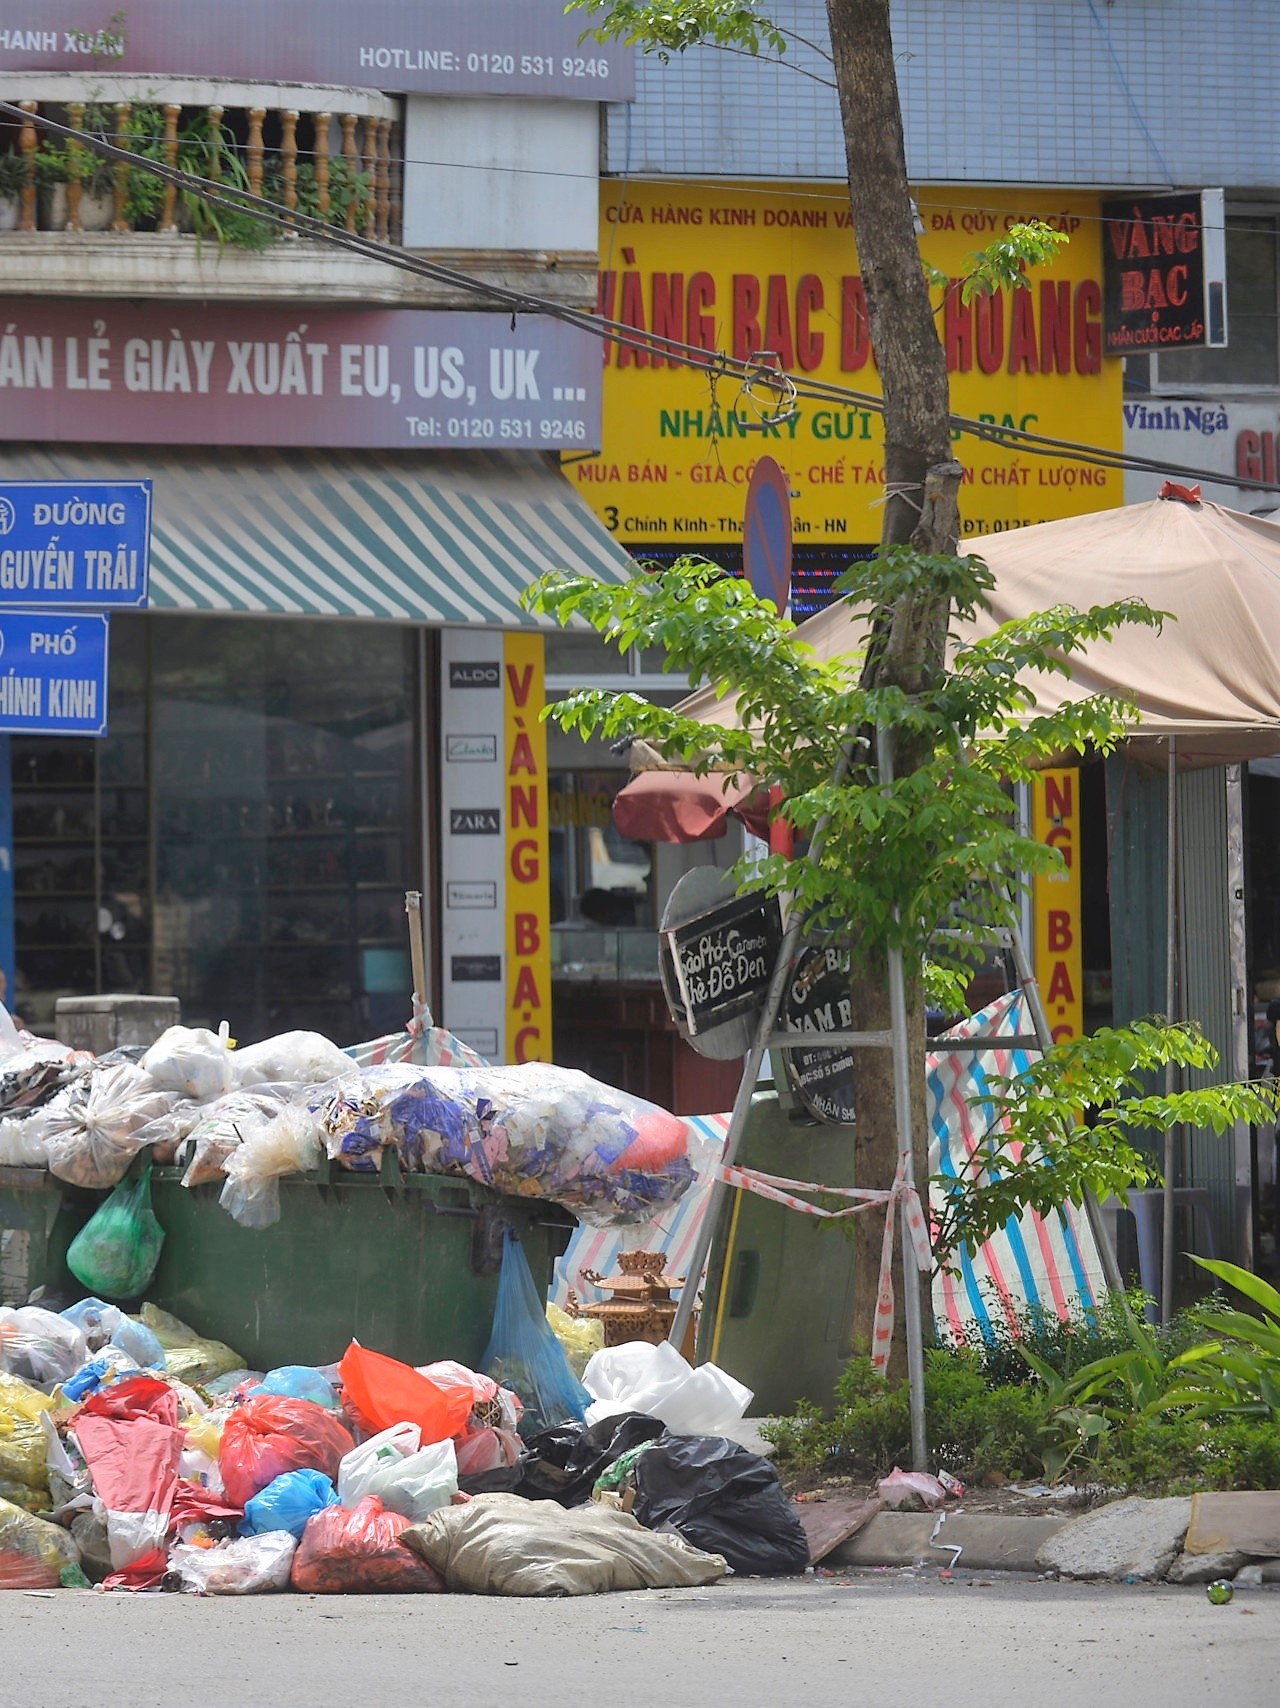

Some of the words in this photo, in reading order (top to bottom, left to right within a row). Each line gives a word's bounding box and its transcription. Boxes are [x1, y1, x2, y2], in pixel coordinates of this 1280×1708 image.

[360, 47, 460, 72] HOTLINE:
[467, 53, 514, 74] 0120
[520, 56, 554, 75] 531
[562, 57, 609, 78] 9246
[605, 201, 644, 223] CỬA
[651, 202, 703, 225] HÀNG
[710, 208, 756, 226] KINH
[763, 209, 828, 228] DOANH
[931, 211, 956, 231] ĐÁ
[1108, 205, 1199, 260] VÀNG
[596, 247, 716, 371] VÀNG
[1121, 264, 1188, 323] BẠC
[66, 320, 111, 390] LẺ
[124, 328, 214, 393] GIÀY
[228, 324, 329, 396] XUẤT
[340, 343, 401, 404] EU,
[414, 346, 476, 406] US,
[489, 348, 540, 400] UK
[406, 417, 440, 438] Tel:
[448, 419, 494, 439] 0120
[500, 420, 532, 439] 531
[540, 420, 586, 441] 9246
[578, 463, 620, 483] MUA
[628, 458, 668, 483] BÁN
[690, 464, 727, 484] GIA
[808, 456, 845, 484] CHẾ
[981, 458, 1031, 486] CHẤT
[1038, 464, 1107, 491] LƯỢNG
[33, 496, 126, 525] ĐƯỜNG
[604, 506, 619, 532] 3
[673, 518, 707, 533] Kinh
[825, 519, 847, 532] HN
[84, 543, 137, 590] TRÃI
[30, 625, 78, 655] PHỐ
[452, 669, 498, 682] ALDO
[48, 678, 96, 719] KINH
[452, 813, 497, 829] ZARA
[686, 976, 708, 1005] hè
[737, 955, 766, 985] Đen
